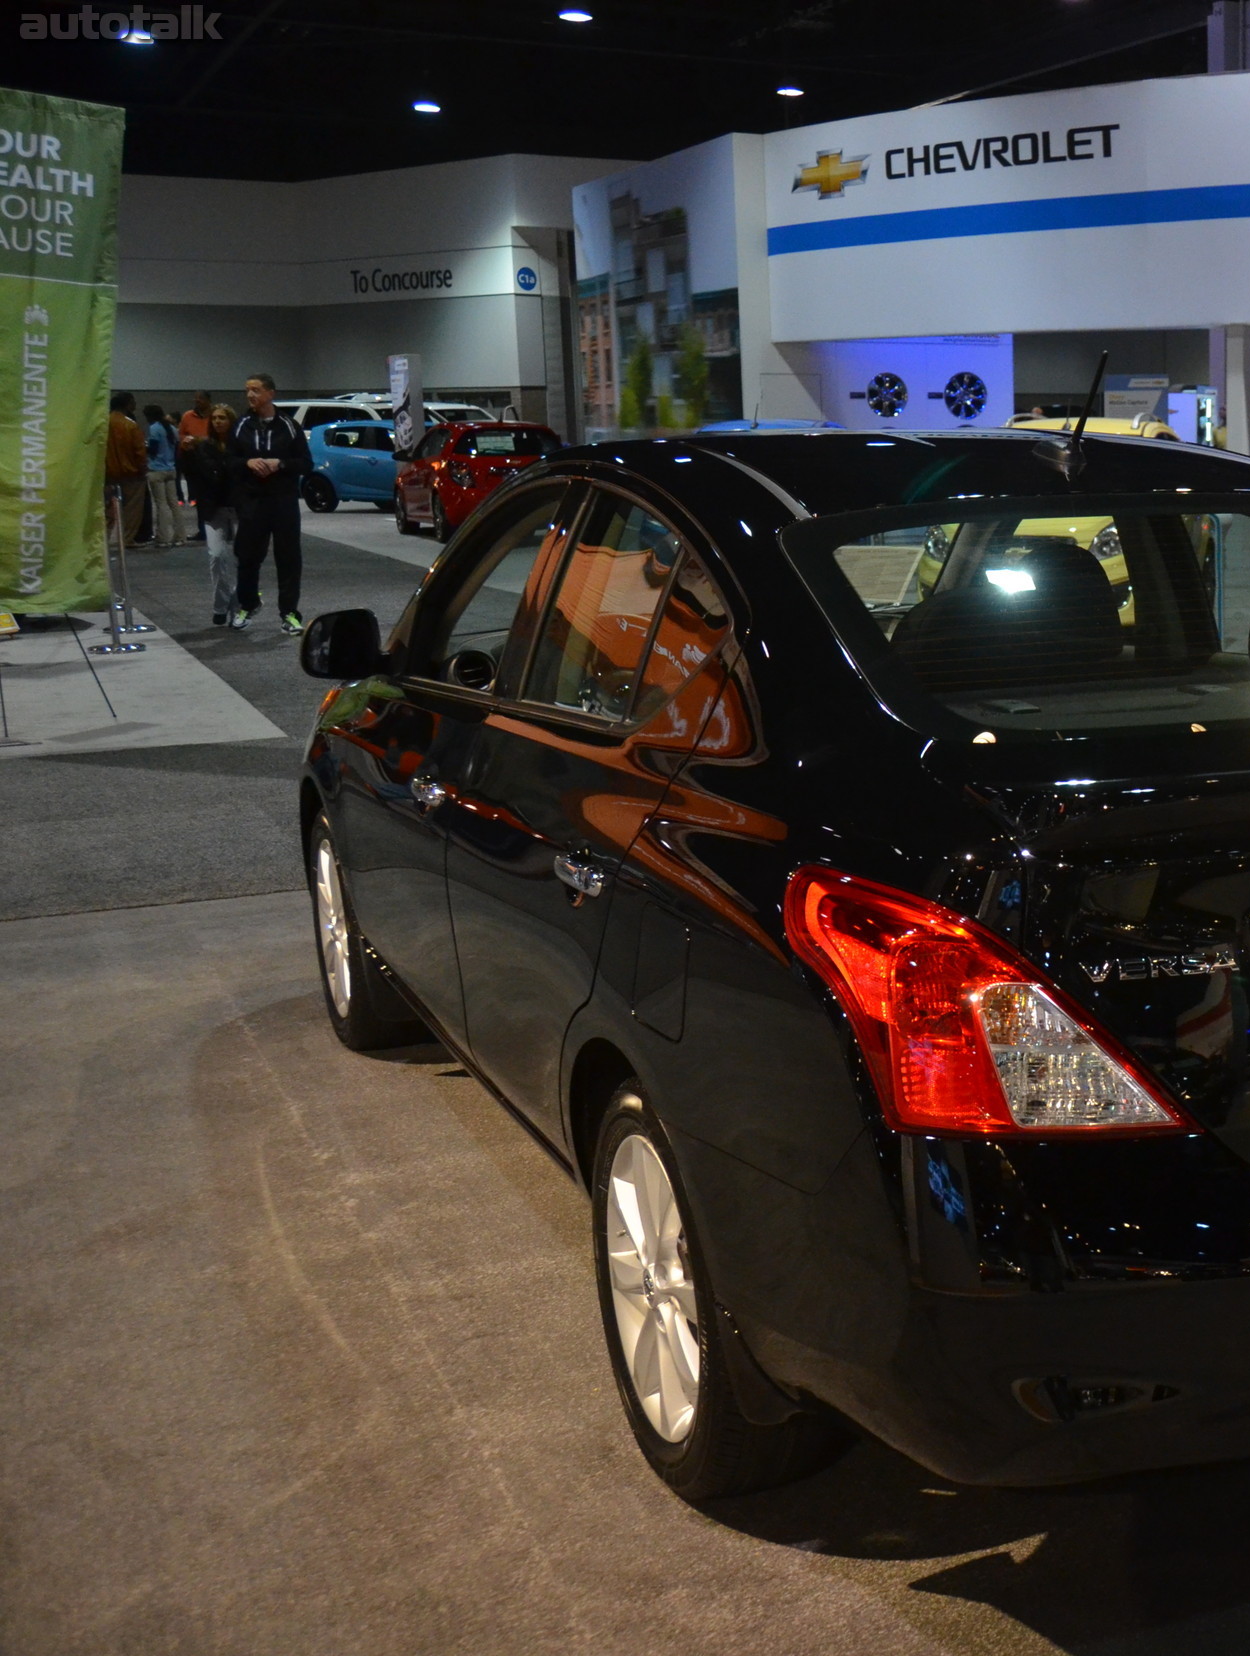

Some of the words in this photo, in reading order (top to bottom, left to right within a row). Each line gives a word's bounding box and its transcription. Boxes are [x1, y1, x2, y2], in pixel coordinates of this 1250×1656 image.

[885, 123, 1120, 180] CHEVROLET
[350, 269, 368, 294] To
[371, 268, 453, 293] Concourse
[518, 273, 536, 285] C1a
[20, 332, 49, 502] PERMANENTE
[18, 512, 46, 594] KAISER
[1078, 950, 1241, 983] VERSA
